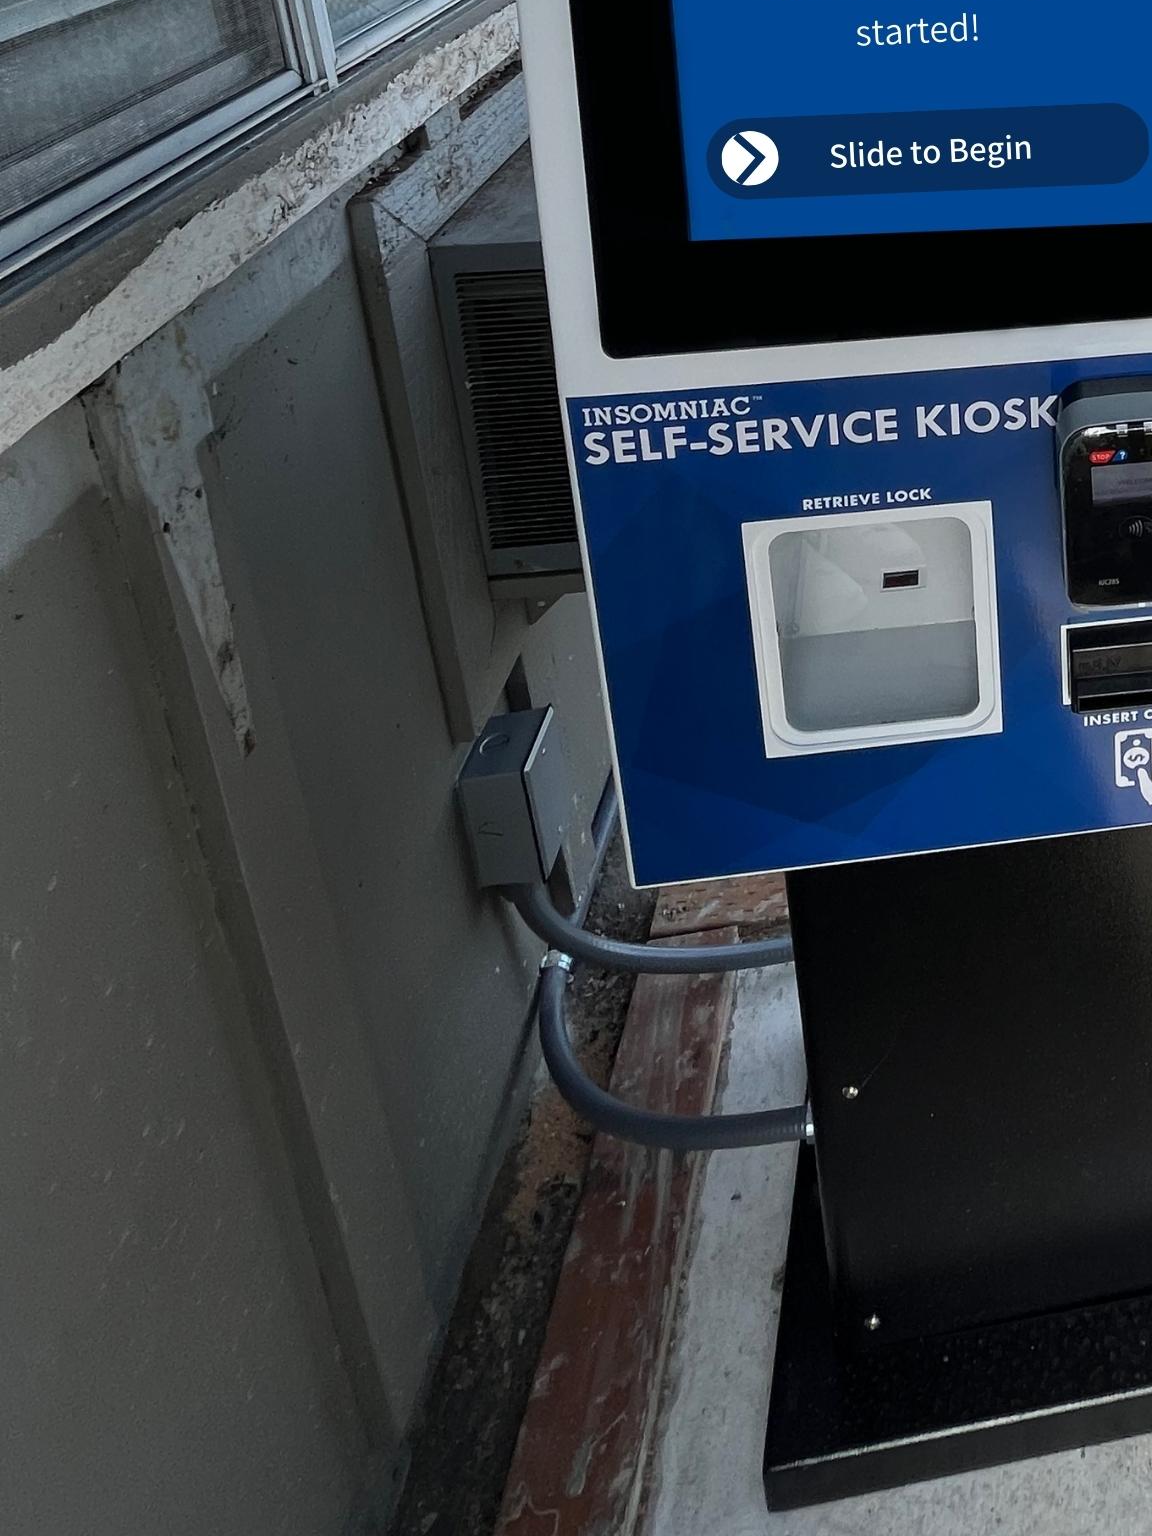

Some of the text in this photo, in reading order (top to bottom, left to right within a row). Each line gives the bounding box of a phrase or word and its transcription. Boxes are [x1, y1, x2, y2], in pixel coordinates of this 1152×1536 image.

[856, 12, 980, 47] started!
[830, 134, 1033, 169] Slide to Begin
[583, 394, 1058, 465] SELF-SERVICE KIOSK
[1092, 453, 1111, 461] STOP
[802, 487, 933, 511] RETRIEVE LOCK
[1083, 710, 1139, 727] INSERT
